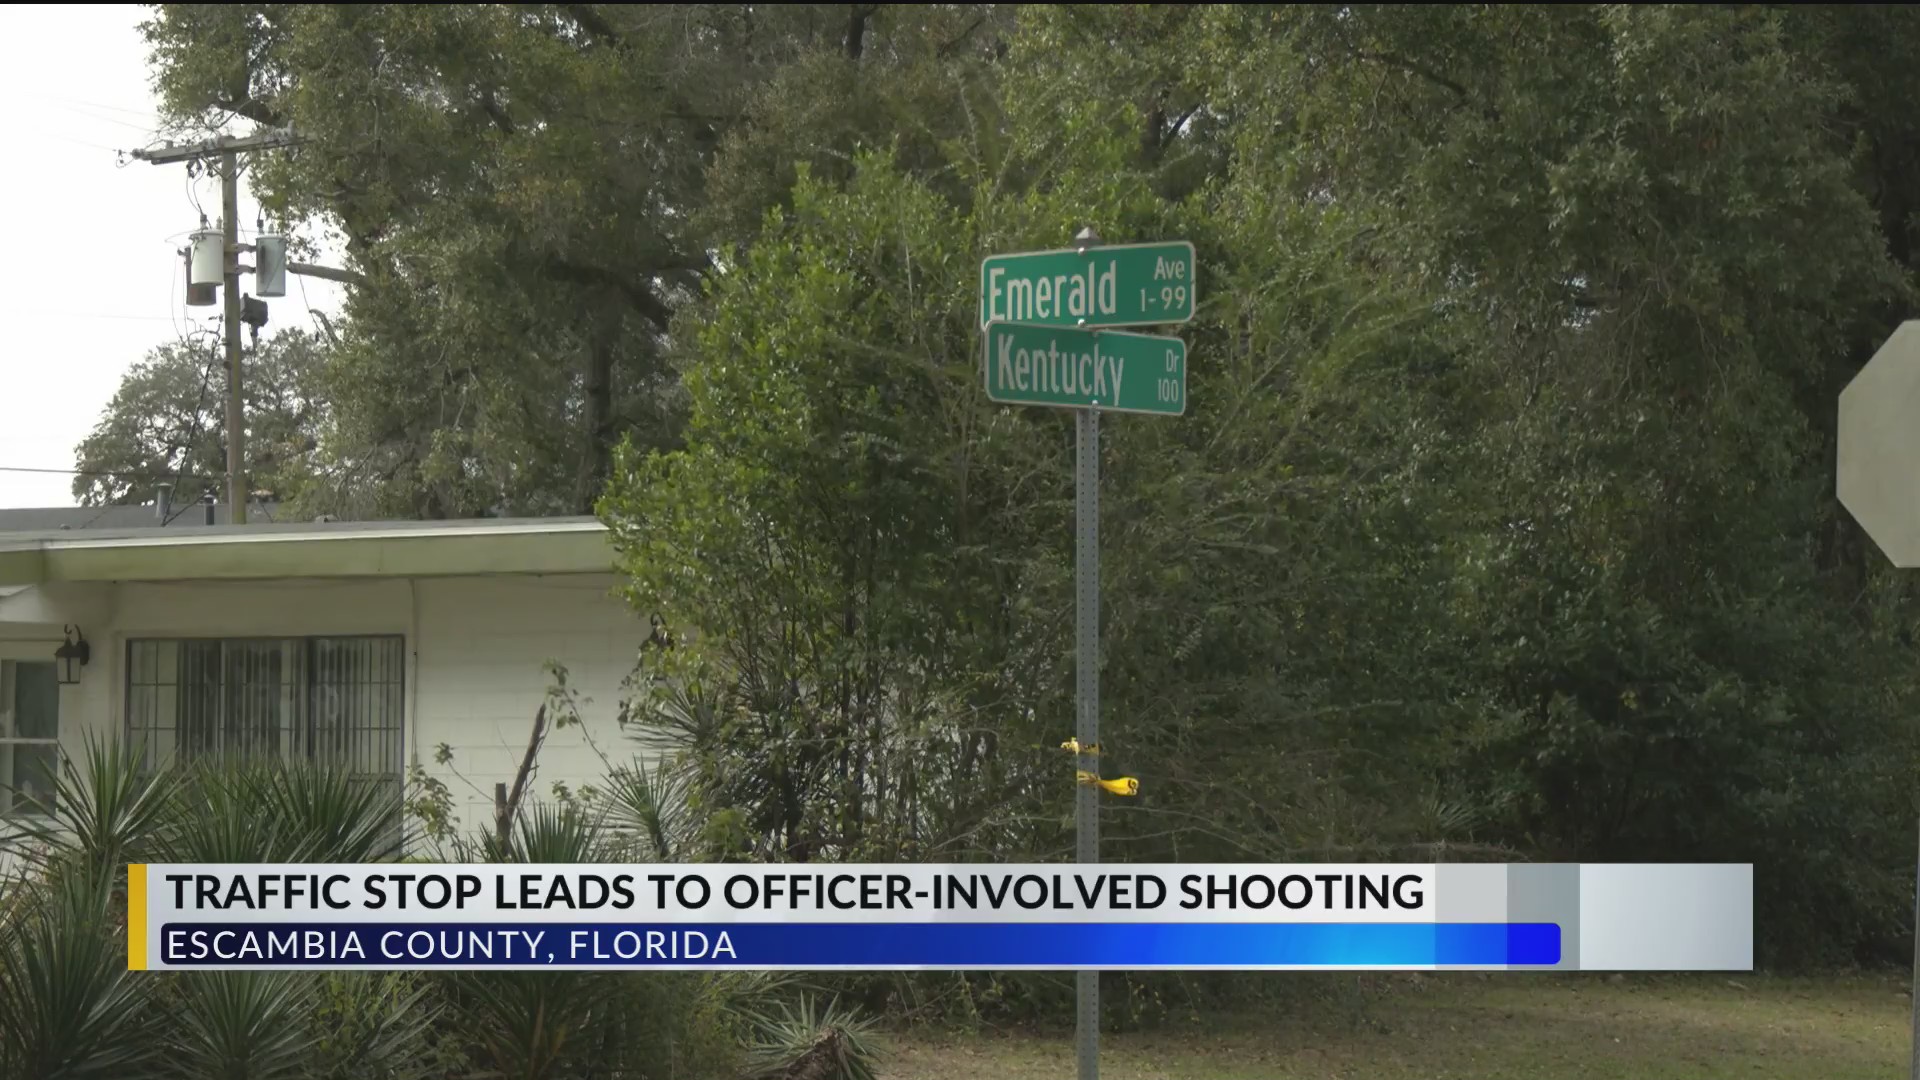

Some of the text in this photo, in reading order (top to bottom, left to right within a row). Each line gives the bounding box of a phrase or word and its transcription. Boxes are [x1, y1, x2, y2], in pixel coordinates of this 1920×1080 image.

[1154, 256, 1185, 281] Ave
[989, 260, 1117, 320] Emerald
[998, 333, 1124, 406] Kentucky
[1165, 349, 1180, 373] Dr
[1157, 378, 1179, 402] 100
